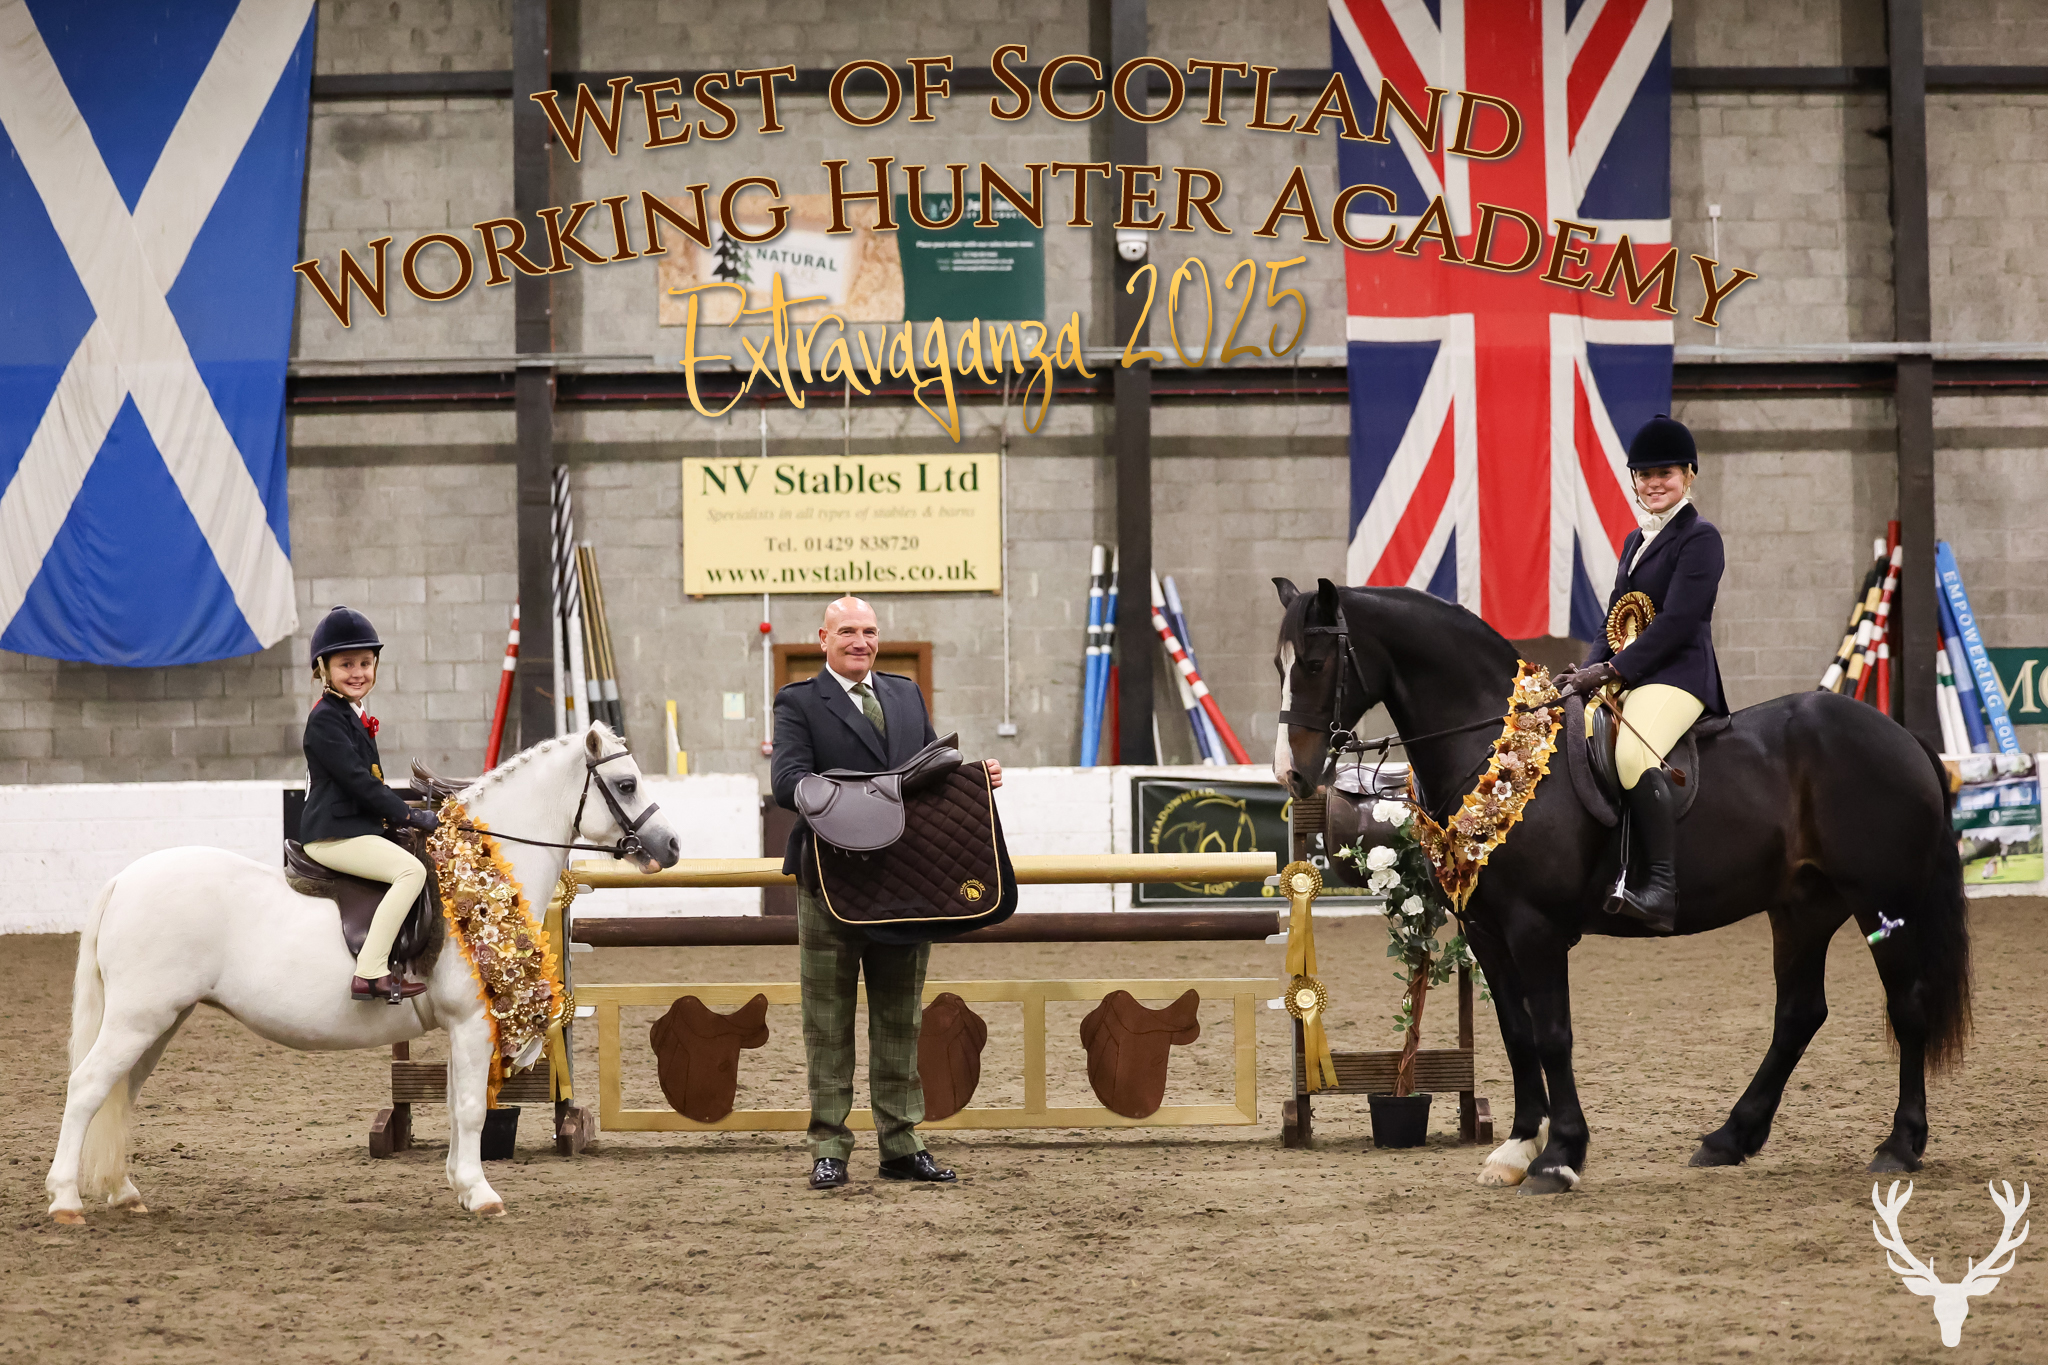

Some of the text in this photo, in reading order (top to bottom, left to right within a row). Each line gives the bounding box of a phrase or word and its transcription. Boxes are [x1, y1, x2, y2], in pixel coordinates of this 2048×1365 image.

[756, 248, 838, 272] NATURAL
[701, 462, 979, 496] NV Stables Ltd
[708, 506, 975, 522] Specialists in all types of stables & barns
[765, 535, 919, 552] Tel. 01429 838720
[706, 560, 977, 583] www.nvstables.co.uk
[1943, 570, 2002, 708] EMPOWERING
[1980, 659, 2048, 713] M
